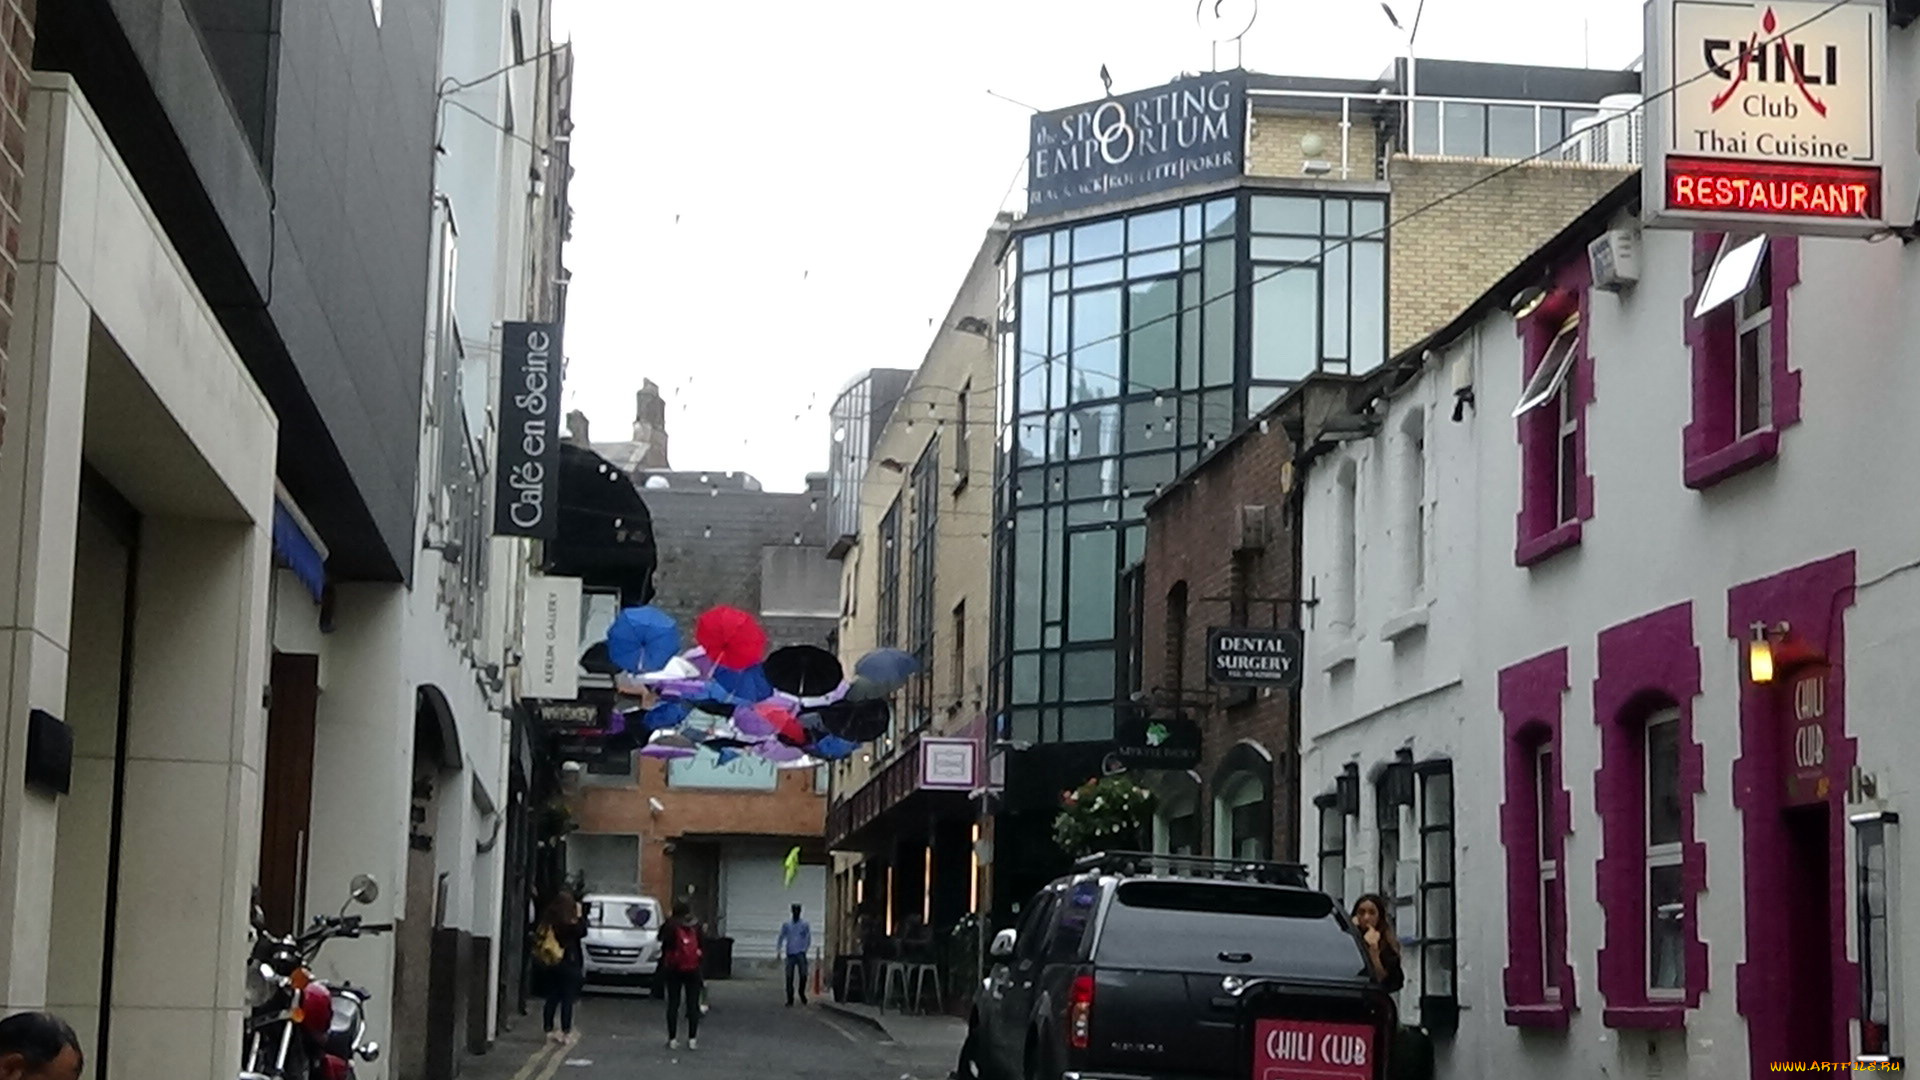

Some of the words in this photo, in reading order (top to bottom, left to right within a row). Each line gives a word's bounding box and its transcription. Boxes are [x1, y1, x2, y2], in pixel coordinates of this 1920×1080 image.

[1704, 39, 1837, 86] CHILI
[1061, 80, 1231, 146] SPORTING
[1743, 94, 1799, 119] Club
[1035, 112, 1230, 179] EMPORIUM
[1185, 150, 1234, 174] POKER
[1694, 129, 1747, 153] Thai
[1756, 133, 1849, 159] Cuisine
[1675, 175, 1867, 214] RESTAURANT
[514, 330, 550, 415] Seine
[522, 419, 546, 456] en
[509, 461, 544, 528] Café
[1216, 655, 1292, 671] SURGERY
[1220, 637, 1285, 653] DENTAL
[1794, 676, 1824, 721] CHILI
[1794, 723, 1824, 768] CLUB
[1266, 1029, 1314, 1062] CHILI
[1321, 1033, 1366, 1066] CLUB
